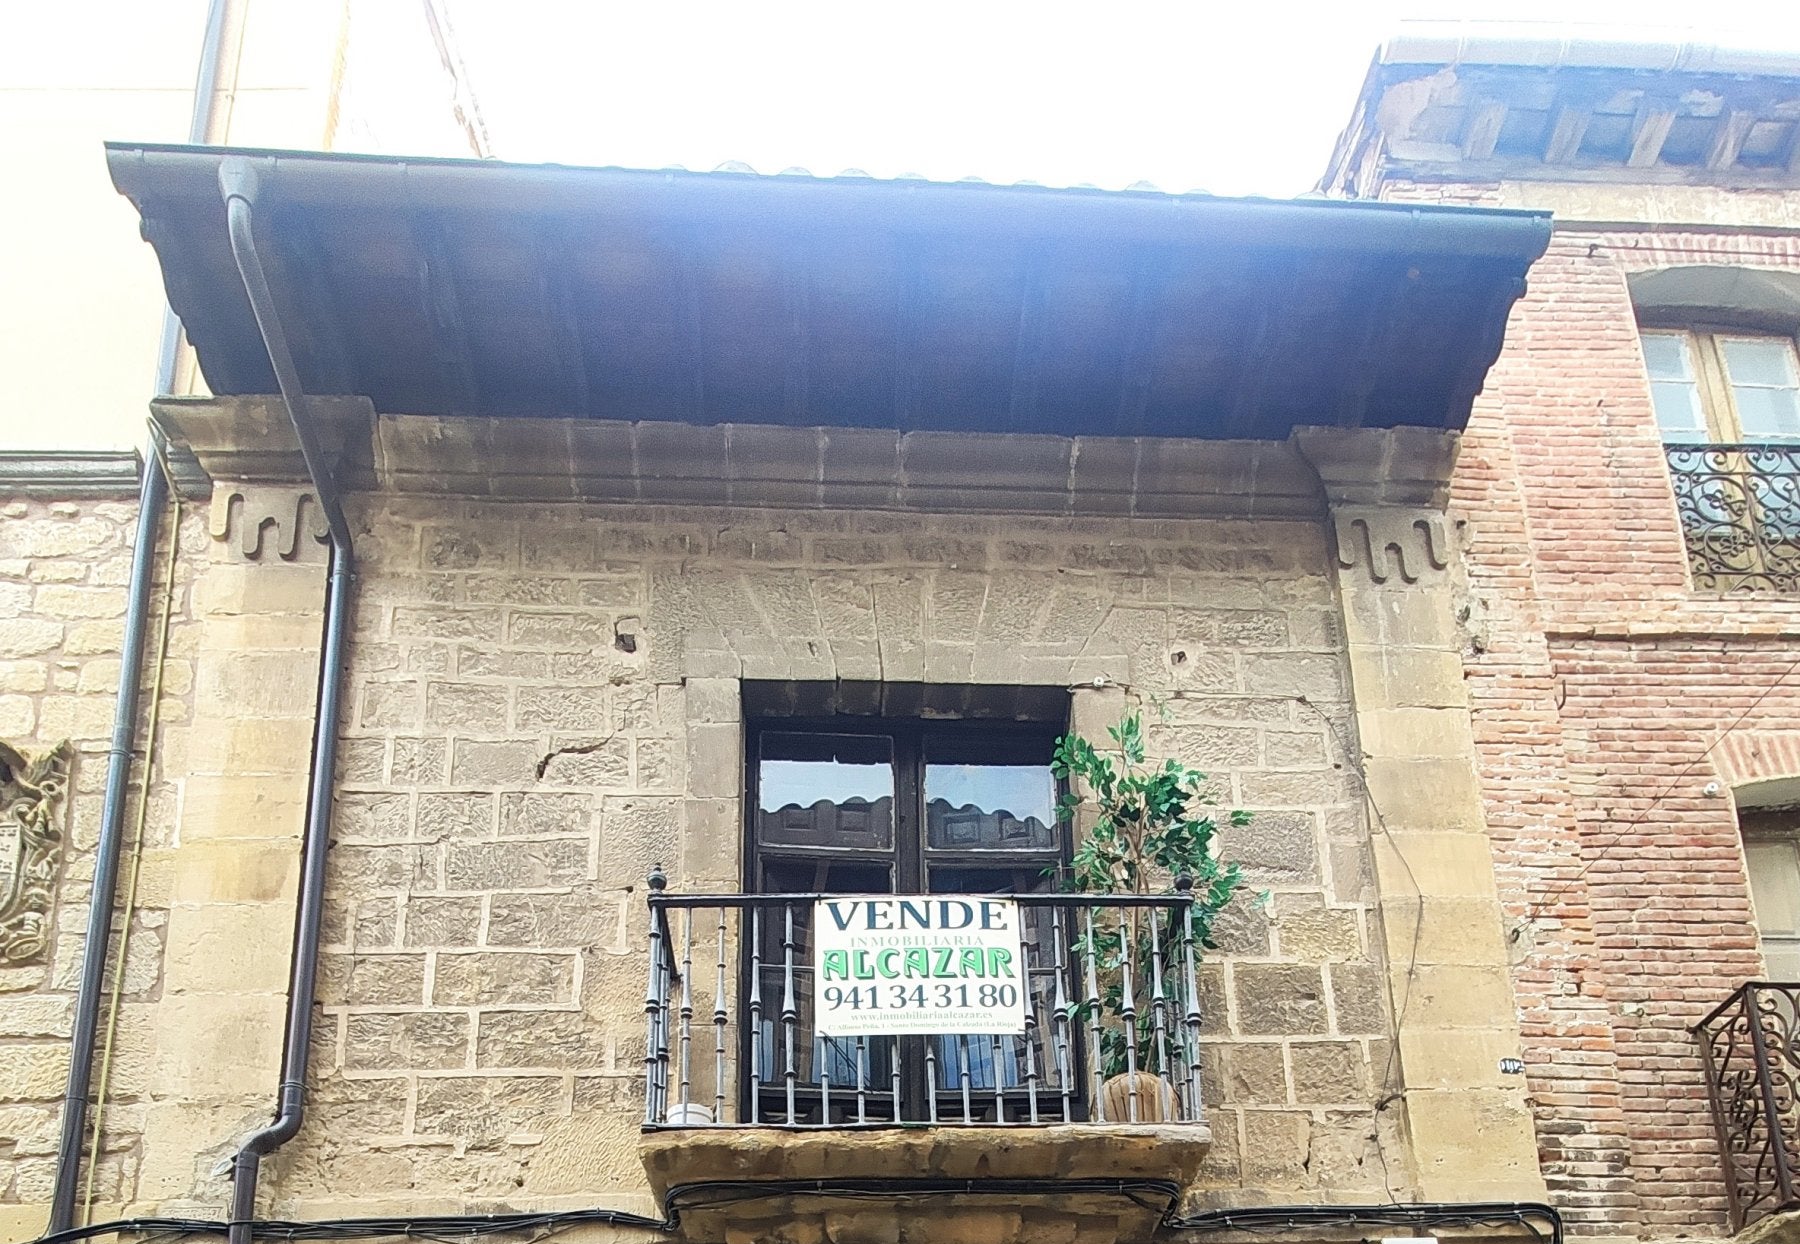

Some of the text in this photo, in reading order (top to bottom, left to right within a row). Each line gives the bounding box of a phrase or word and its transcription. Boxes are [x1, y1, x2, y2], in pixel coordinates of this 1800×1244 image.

[826, 900, 1008, 931] VENDE
[850, 935, 984, 948] INMOBILIARIA
[823, 947, 1017, 981] ALCAZAR
[824, 983, 1017, 1011] 941 34 31 80
[850, 1010, 993, 1022] www.inmobiliariaalcazar.es
